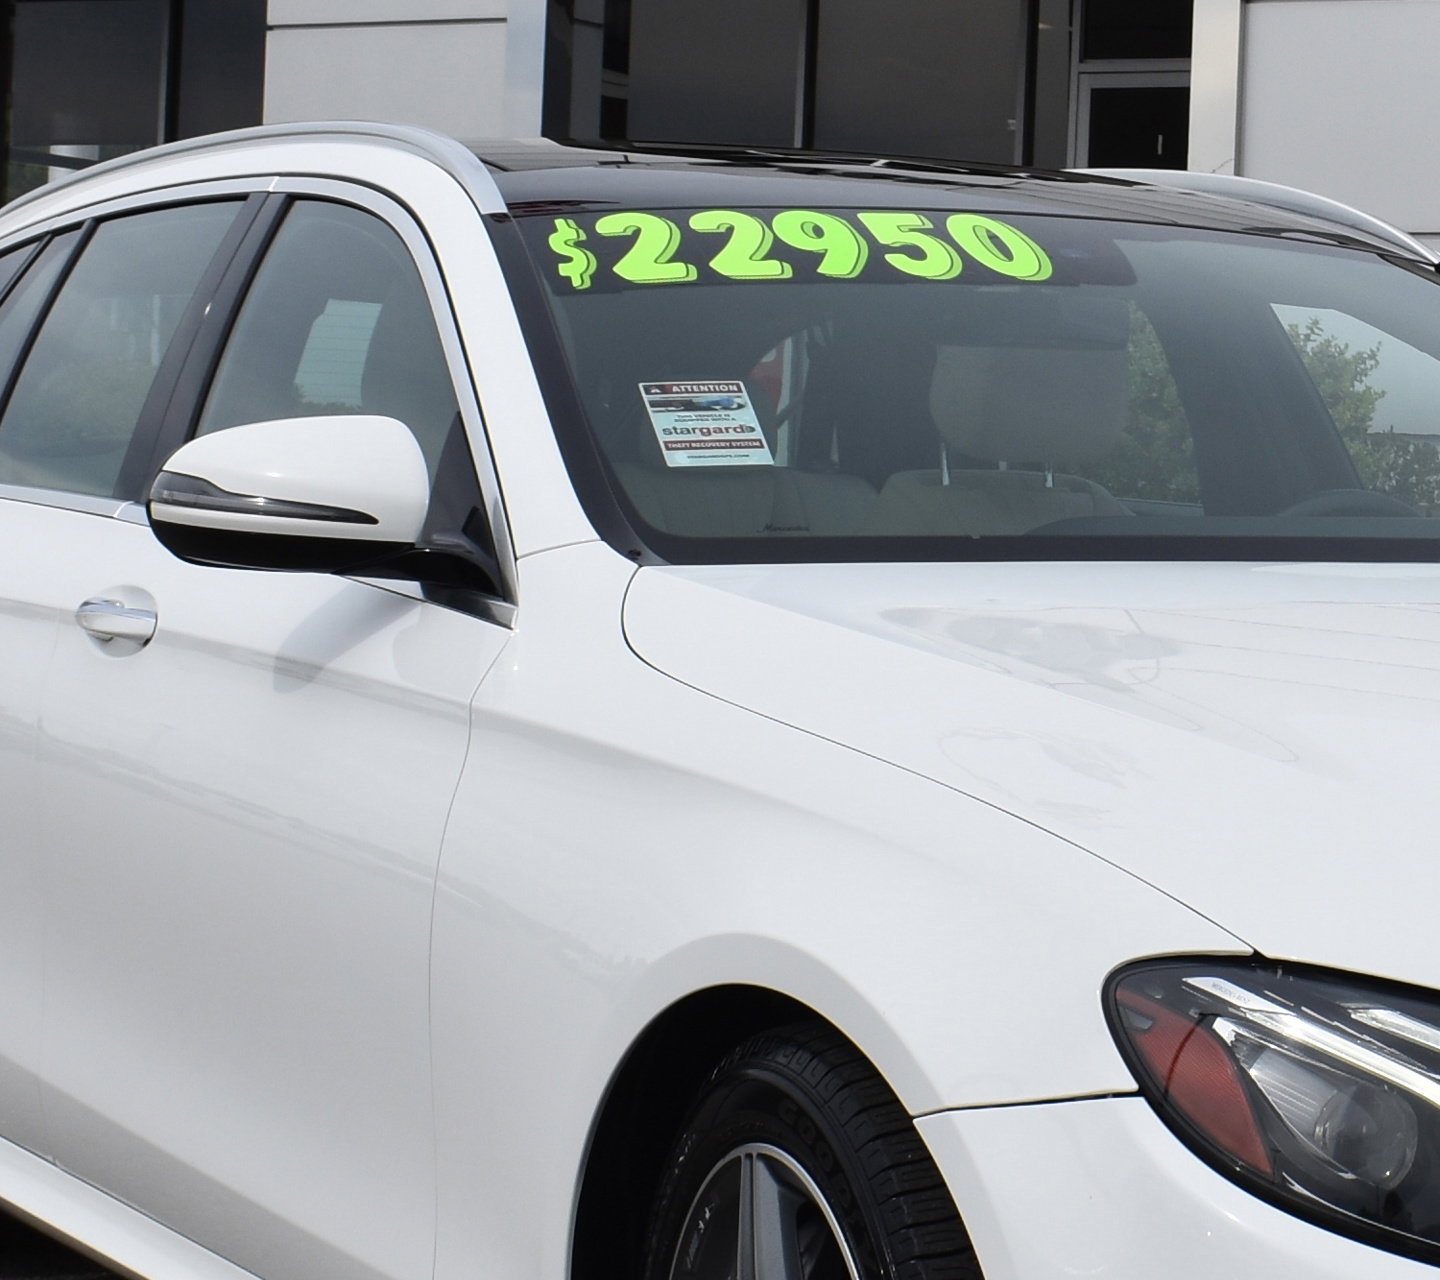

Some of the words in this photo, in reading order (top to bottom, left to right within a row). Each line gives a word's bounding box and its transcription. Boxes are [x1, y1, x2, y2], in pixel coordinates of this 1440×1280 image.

[547, 210, 1053, 290] $22950
[672, 384, 738, 393] ATTENTION
[662, 424, 745, 437] stargard
